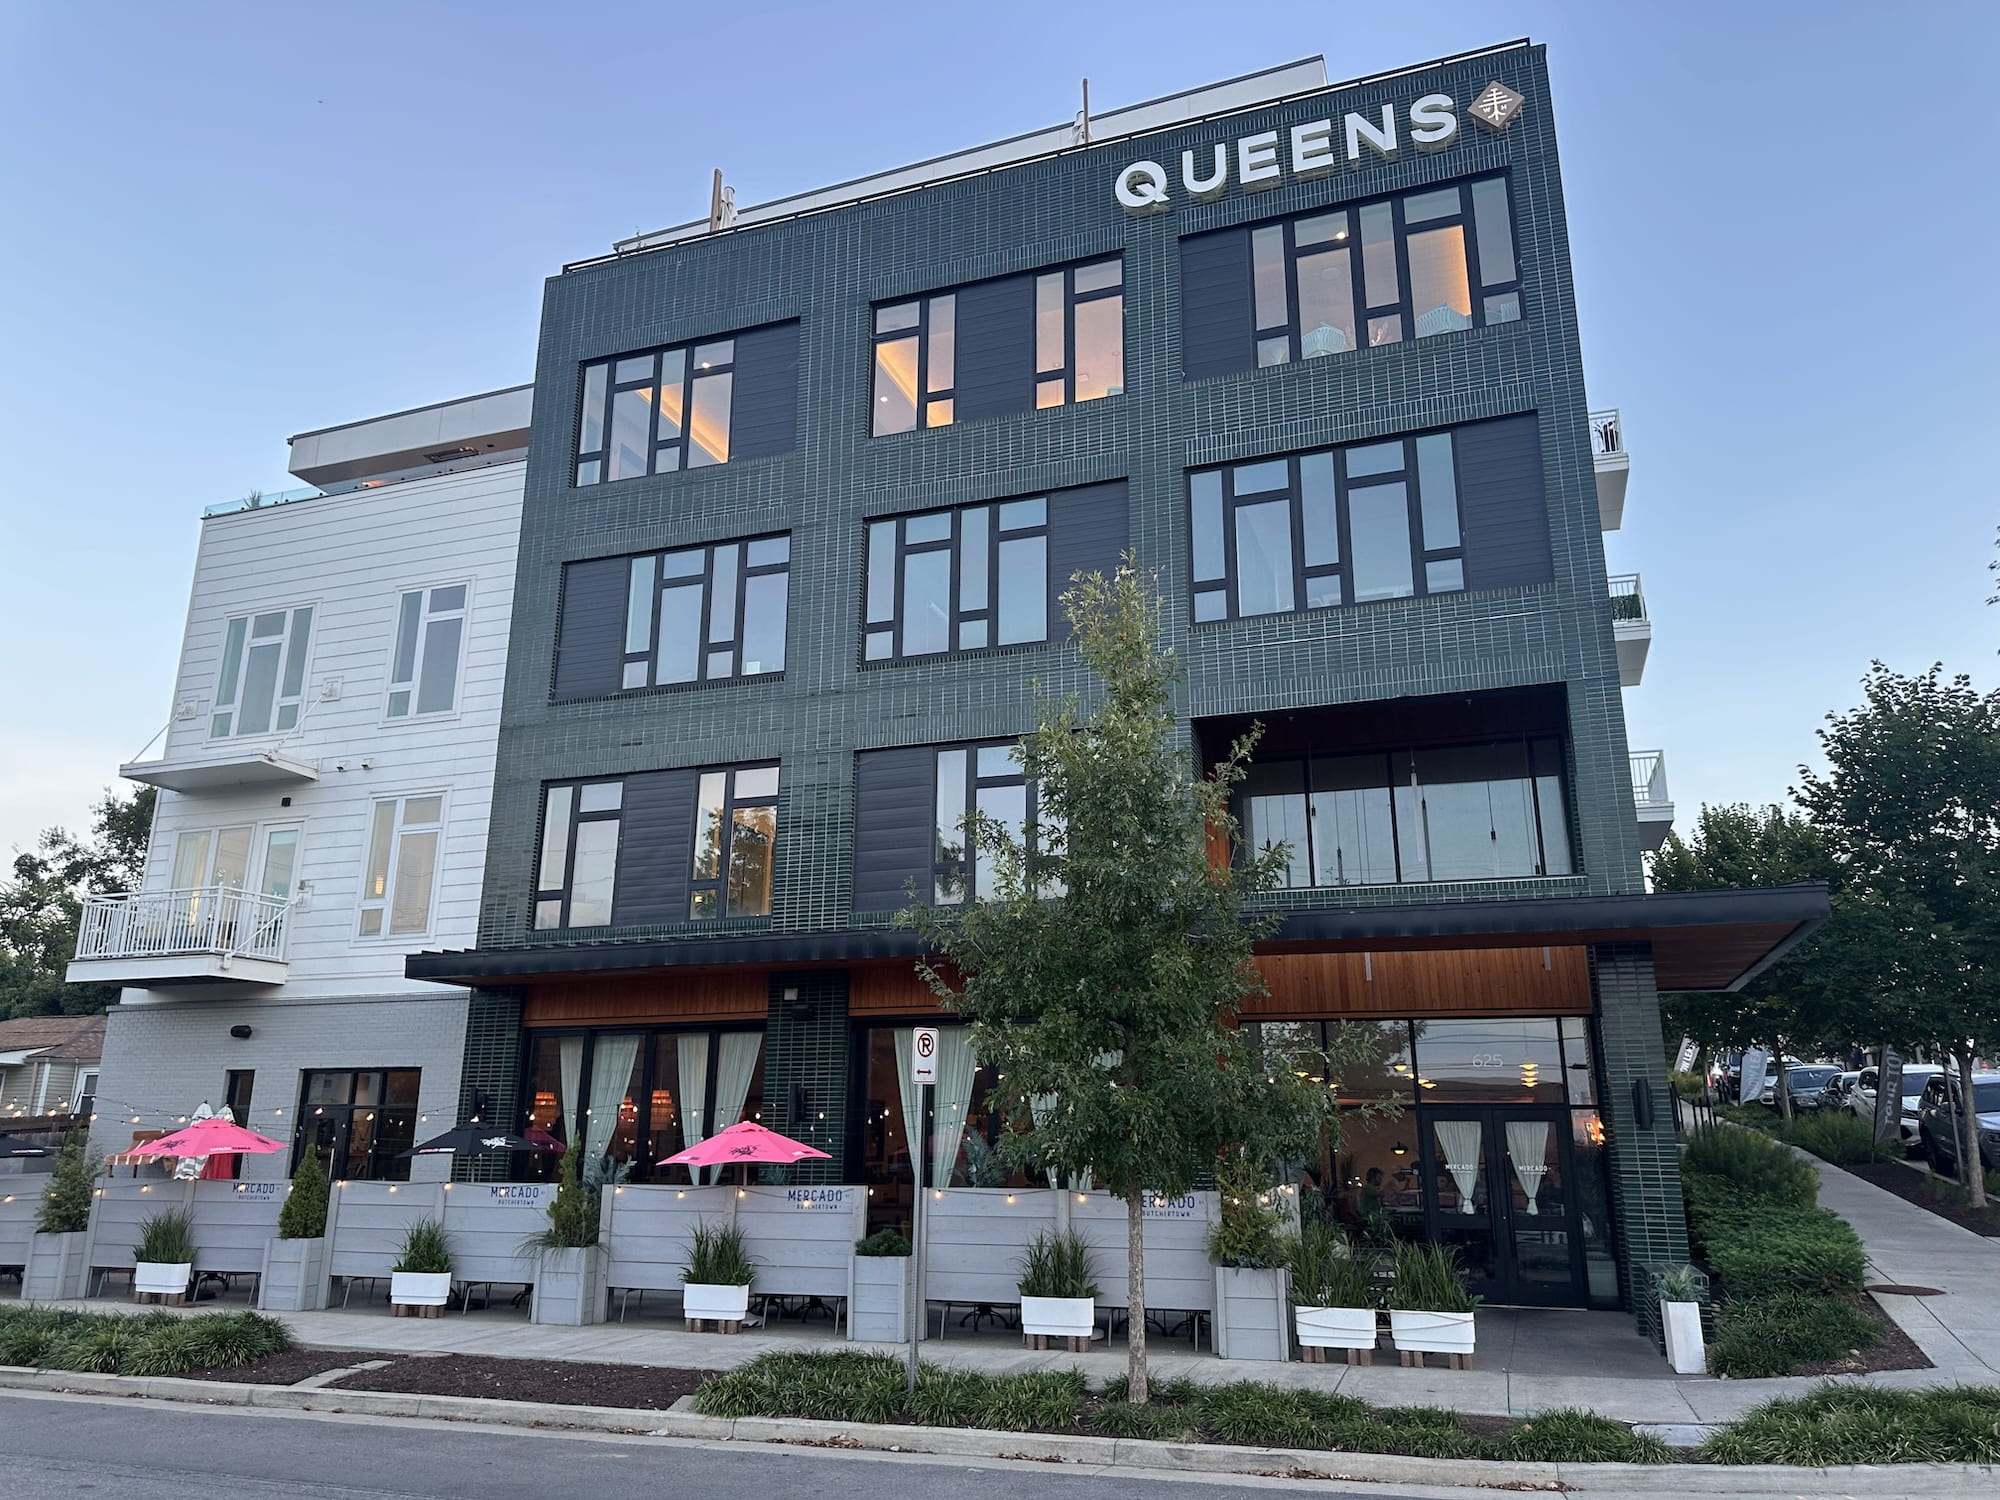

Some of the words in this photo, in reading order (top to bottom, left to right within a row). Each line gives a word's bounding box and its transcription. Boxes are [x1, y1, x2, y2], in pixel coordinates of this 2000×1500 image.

[1114, 93, 1458, 209] QUEENS
[1472, 1054, 1503, 1068] 625
[1445, 1163, 1474, 1171] MERCADO
[232, 1182, 275, 1194] MRCADO
[787, 1189, 843, 1202] MERCADO
[1141, 1195, 1196, 1209] ERCADO
